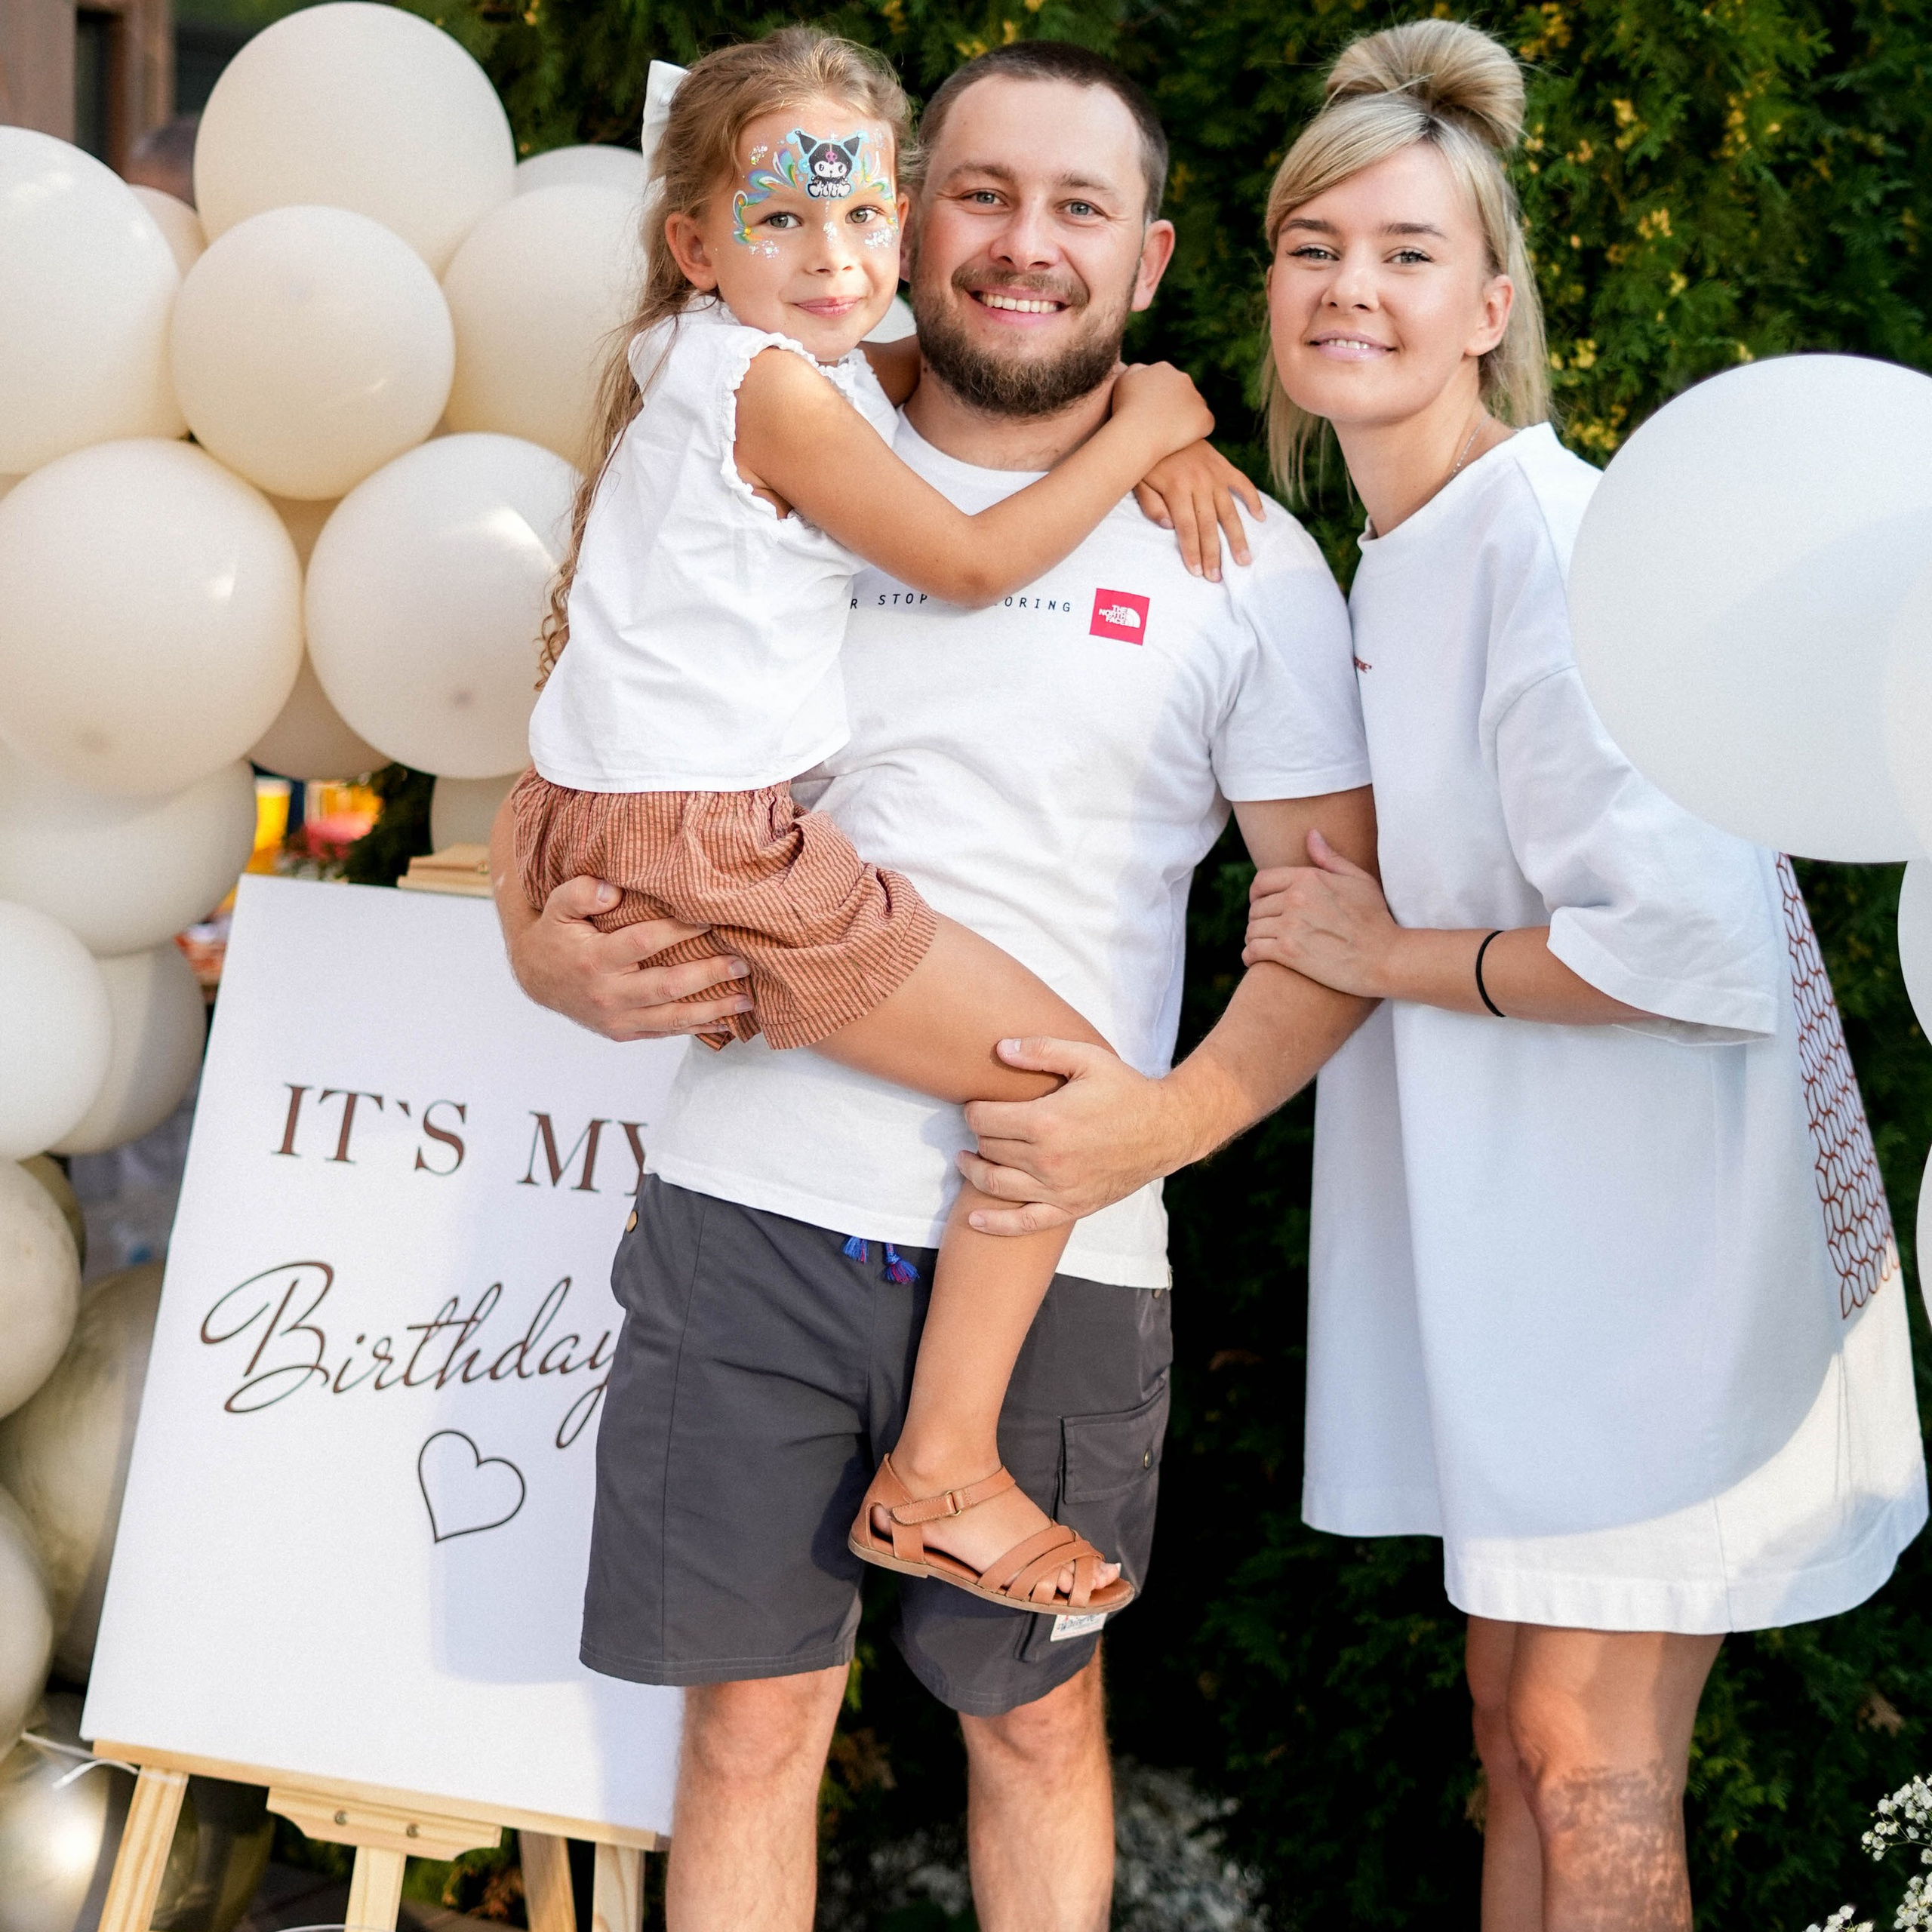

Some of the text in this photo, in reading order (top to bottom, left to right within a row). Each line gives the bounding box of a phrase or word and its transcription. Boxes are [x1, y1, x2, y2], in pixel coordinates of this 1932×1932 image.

[878, 593, 928, 605] STOP
[994, 596, 1071, 613] ORING
[1099, 608, 1127, 620] NORTH
[1112, 605, 1128, 614] THE
[1106, 615, 1126, 626] FACE
[200, 1261, 616, 1449] Birthday
